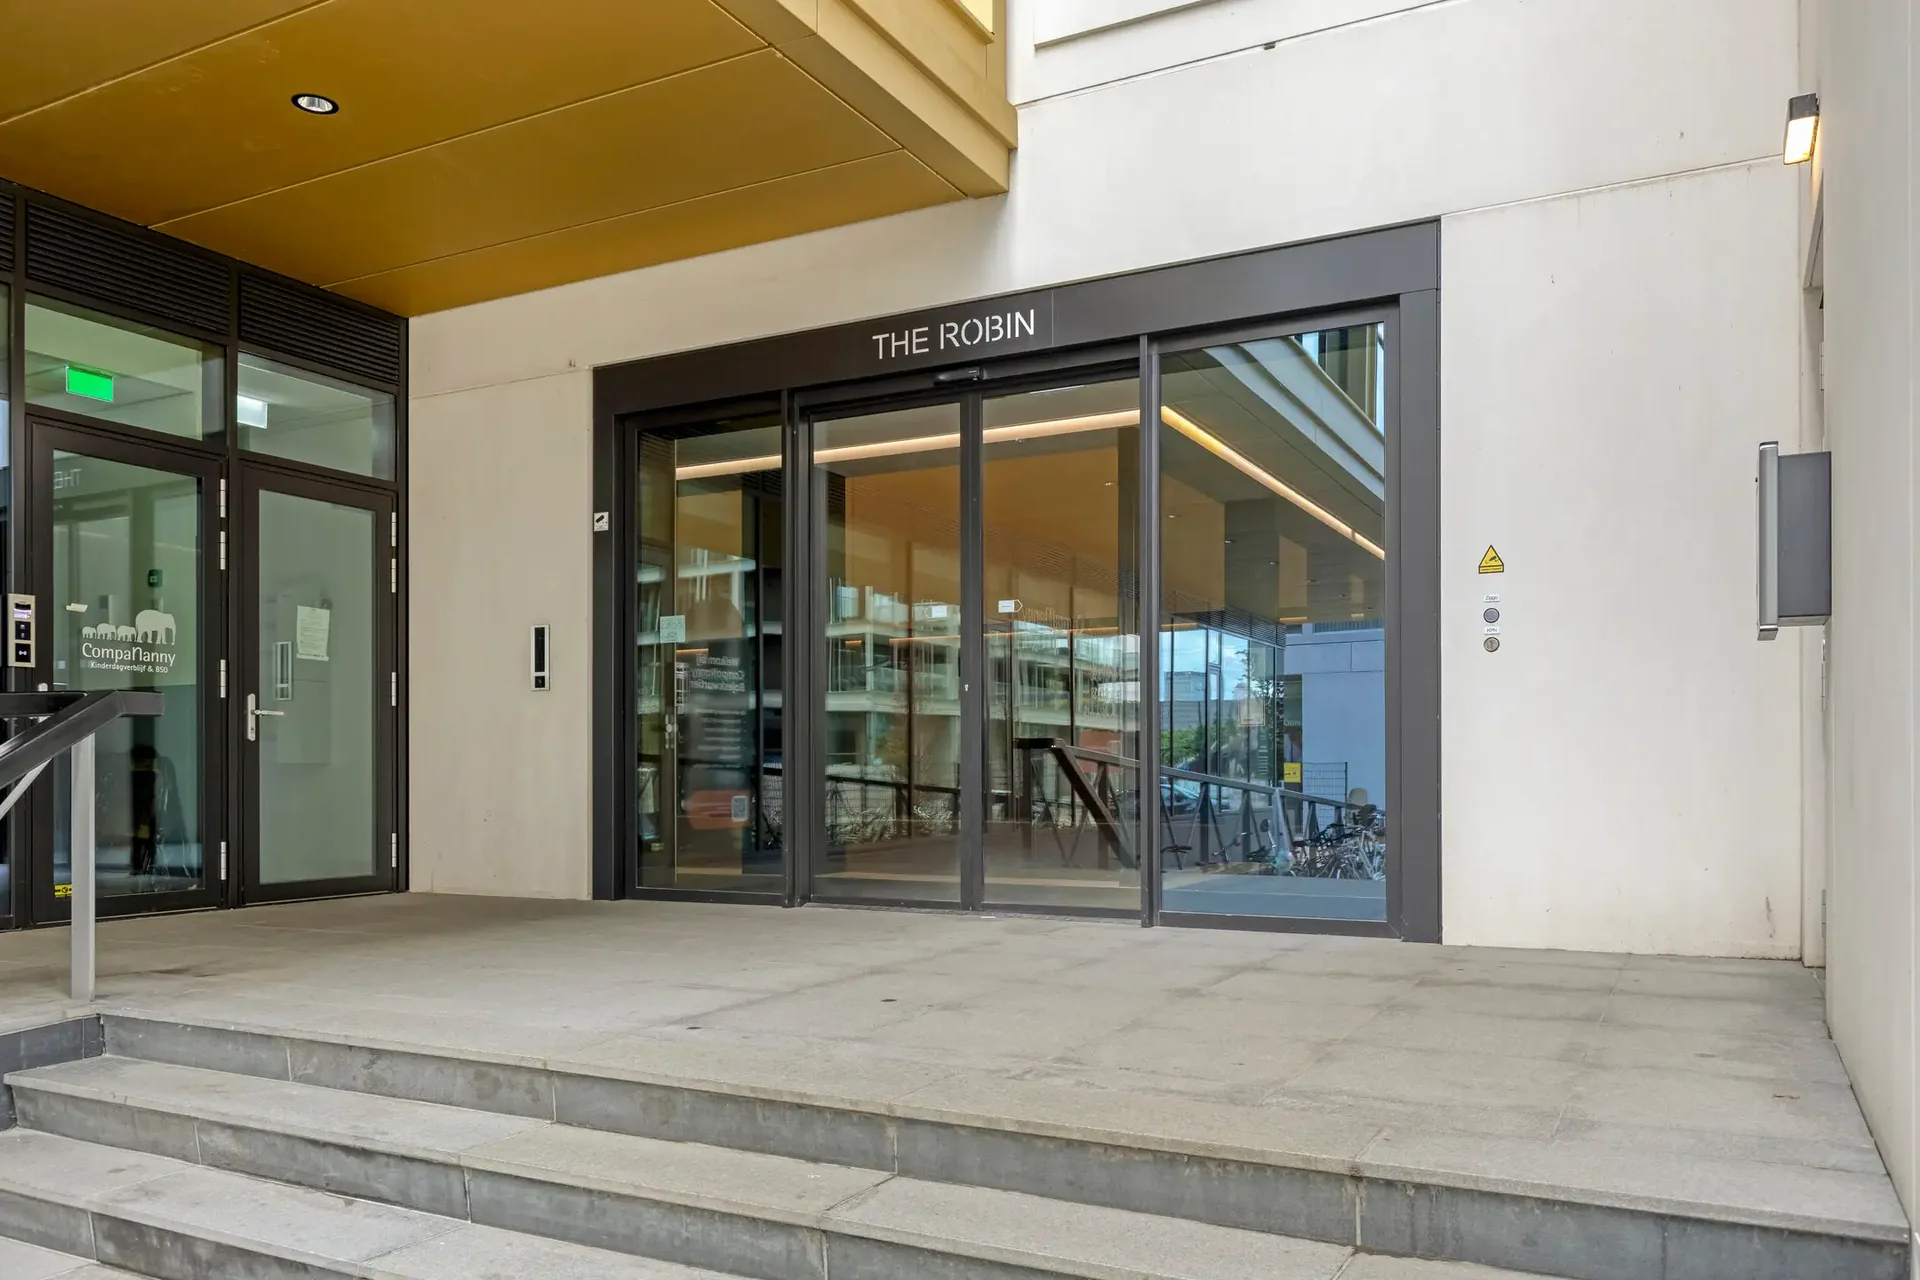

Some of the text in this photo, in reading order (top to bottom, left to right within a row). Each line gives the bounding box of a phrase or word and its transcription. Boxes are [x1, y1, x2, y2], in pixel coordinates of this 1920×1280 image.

[872, 309, 1035, 360] THE ROBIN
[90, 661, 146, 673] Kinderdagverblijf
[147, 665, 154, 673] &
